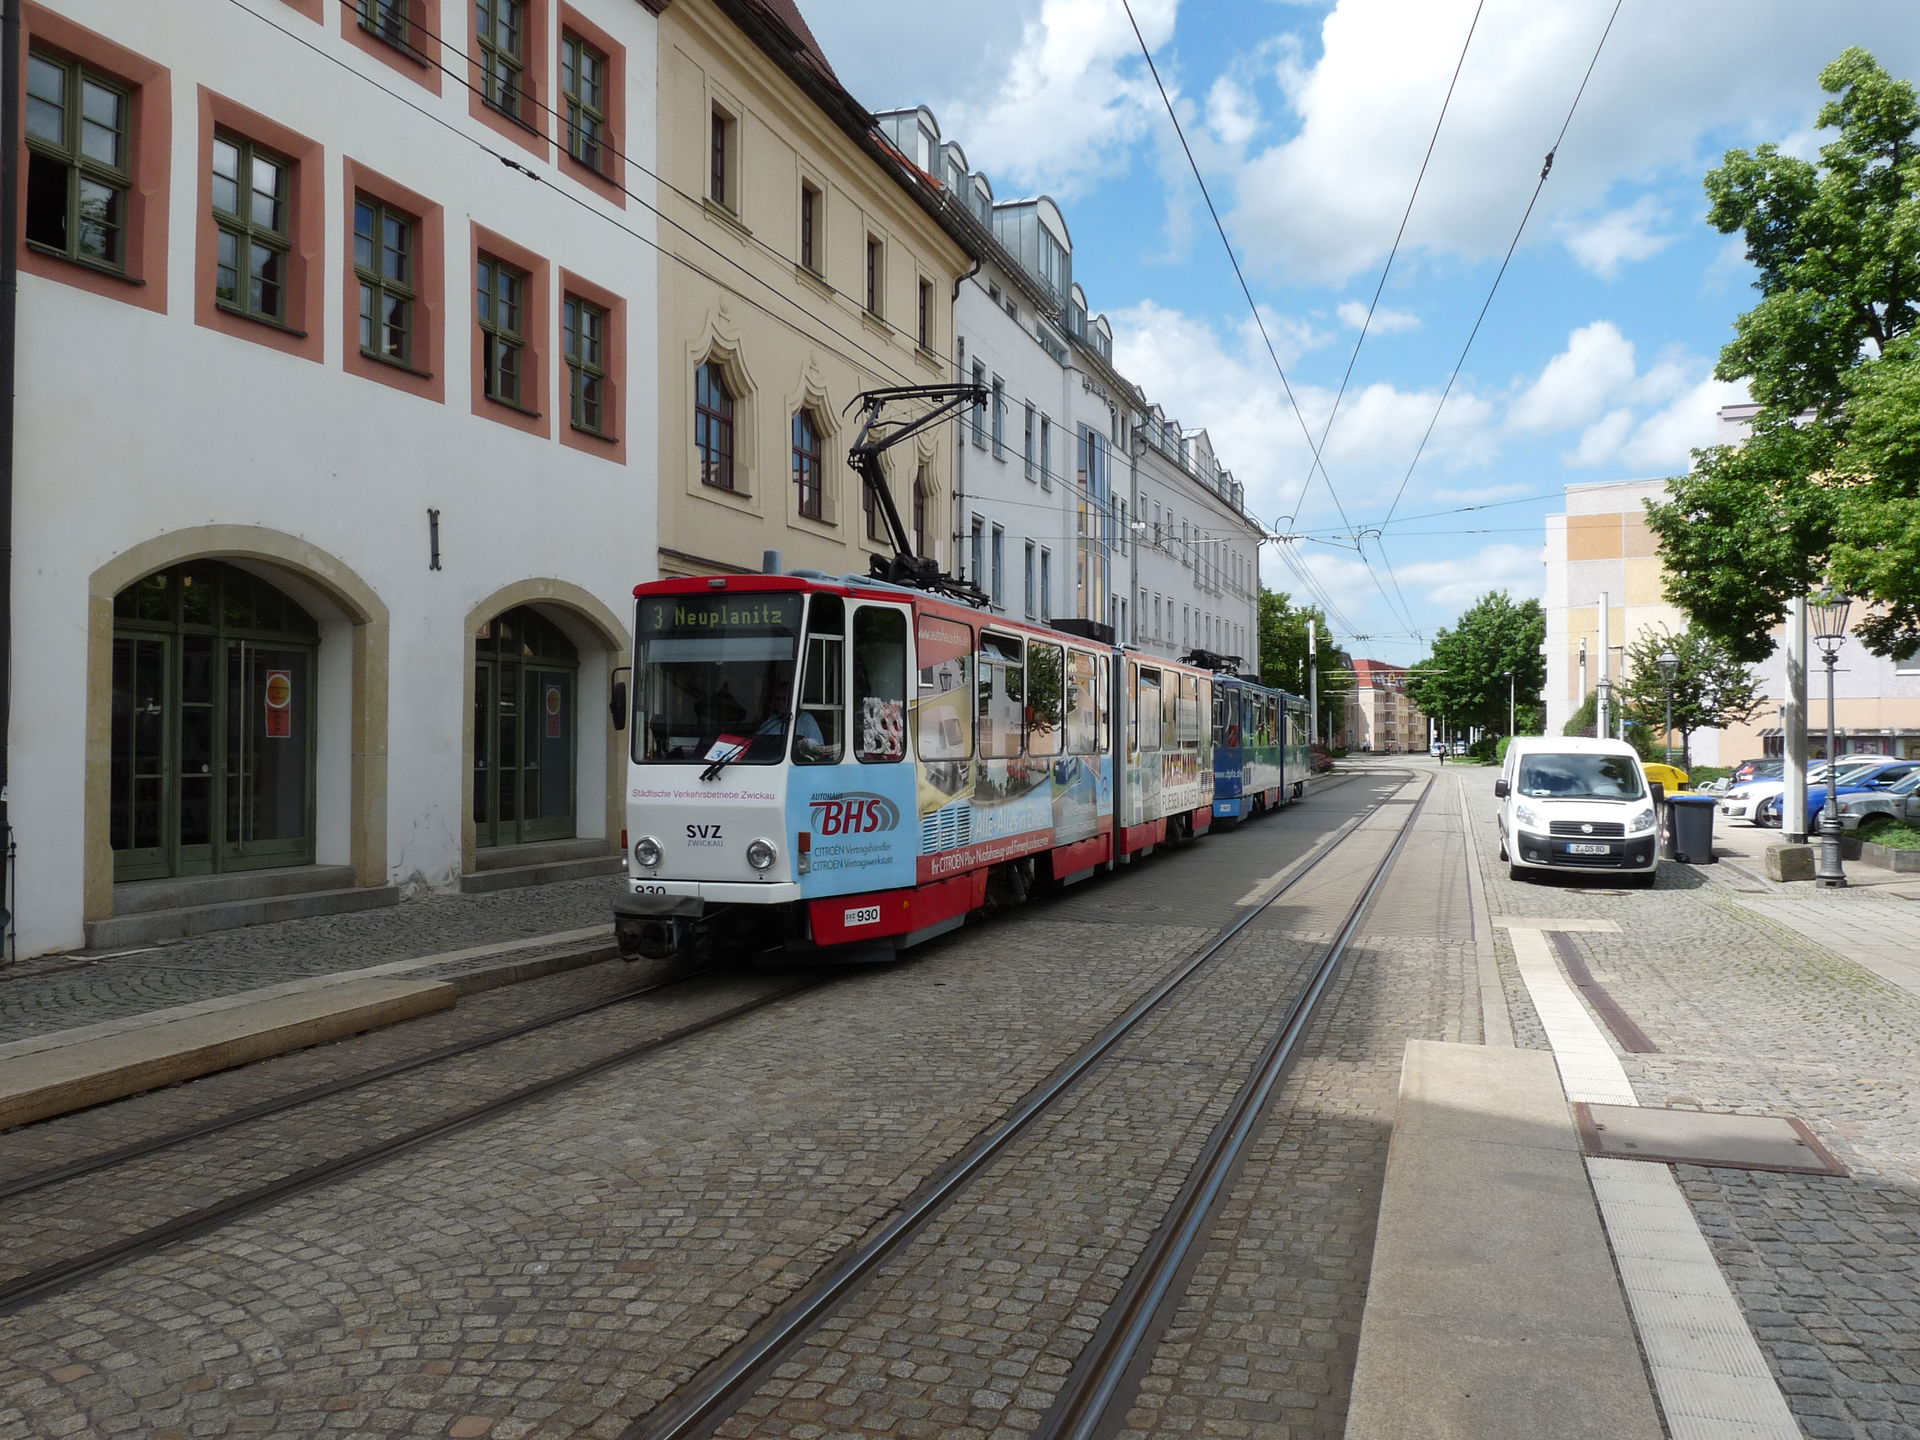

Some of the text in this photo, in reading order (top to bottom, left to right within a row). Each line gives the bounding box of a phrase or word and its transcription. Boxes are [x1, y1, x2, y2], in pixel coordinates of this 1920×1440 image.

[654, 604, 782, 629] 3 Neuplanitz
[632, 789, 775, 800] Städtische Verkehrsbetriebe Zwickau
[811, 792, 844, 800] AUTOHAUS
[809, 799, 881, 835] BHS
[686, 825, 722, 838] SVZ
[687, 839, 724, 847] ZWICKAU
[844, 855, 893, 869] Vertragswerkstatt
[635, 885, 666, 895] 930
[857, 909, 878, 922] 930
